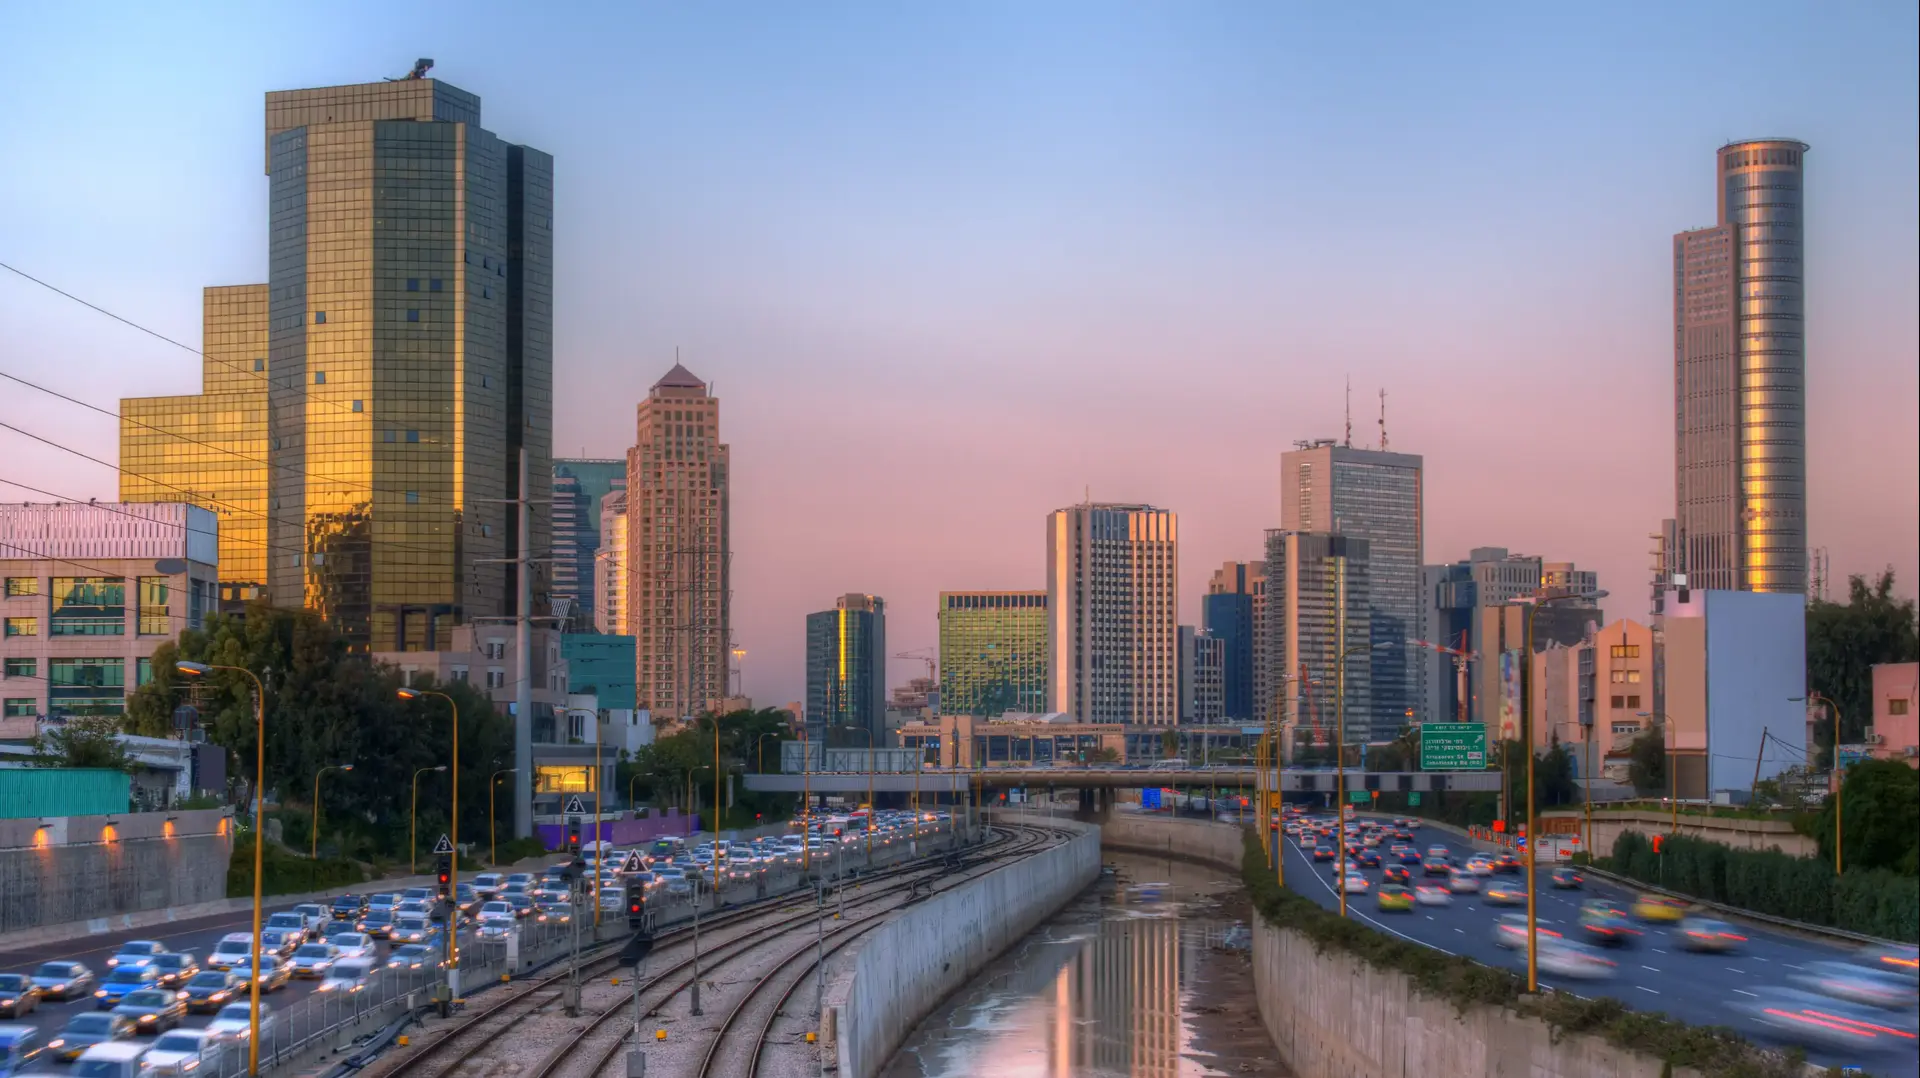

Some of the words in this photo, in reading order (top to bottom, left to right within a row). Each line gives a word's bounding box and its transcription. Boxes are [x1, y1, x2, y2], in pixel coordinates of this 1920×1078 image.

[572, 800, 579, 811] 3
[441, 840, 447, 851] 3
[631, 856, 639, 871] 3
